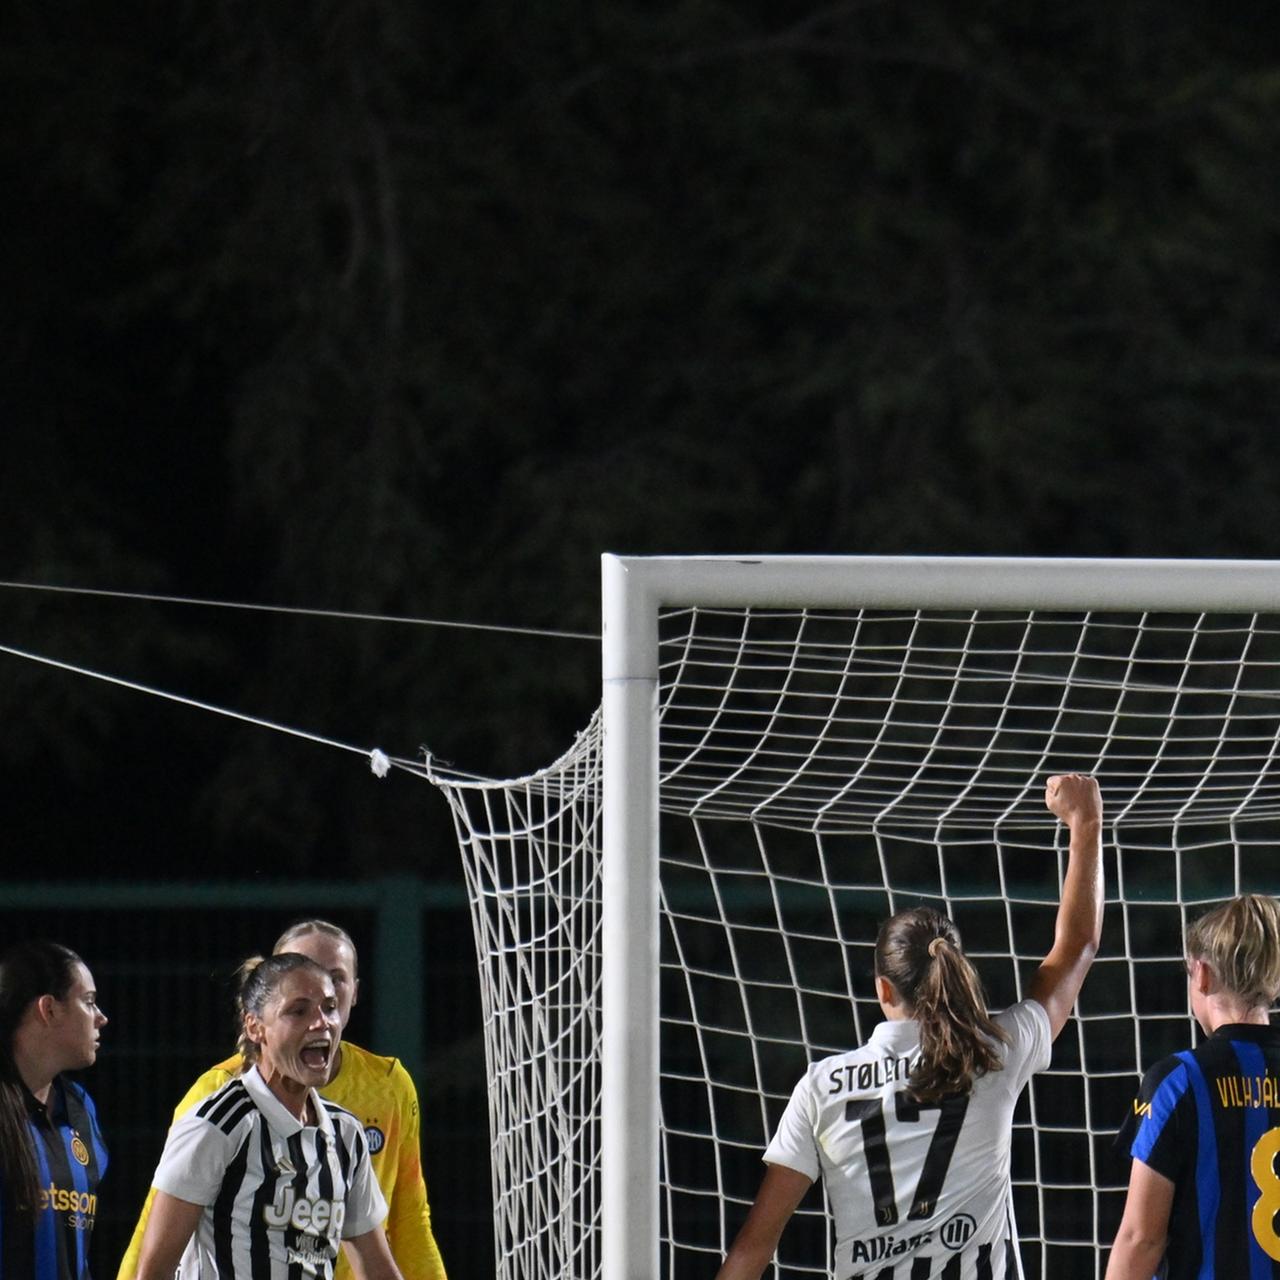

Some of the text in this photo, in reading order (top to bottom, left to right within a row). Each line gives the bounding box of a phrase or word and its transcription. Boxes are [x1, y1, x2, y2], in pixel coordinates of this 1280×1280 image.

[828, 1055, 912, 1095] STØLEN
[844, 1090, 971, 1228] 17
[263, 1185, 346, 1239] Jeep
[851, 1230, 933, 1264] Allianz
